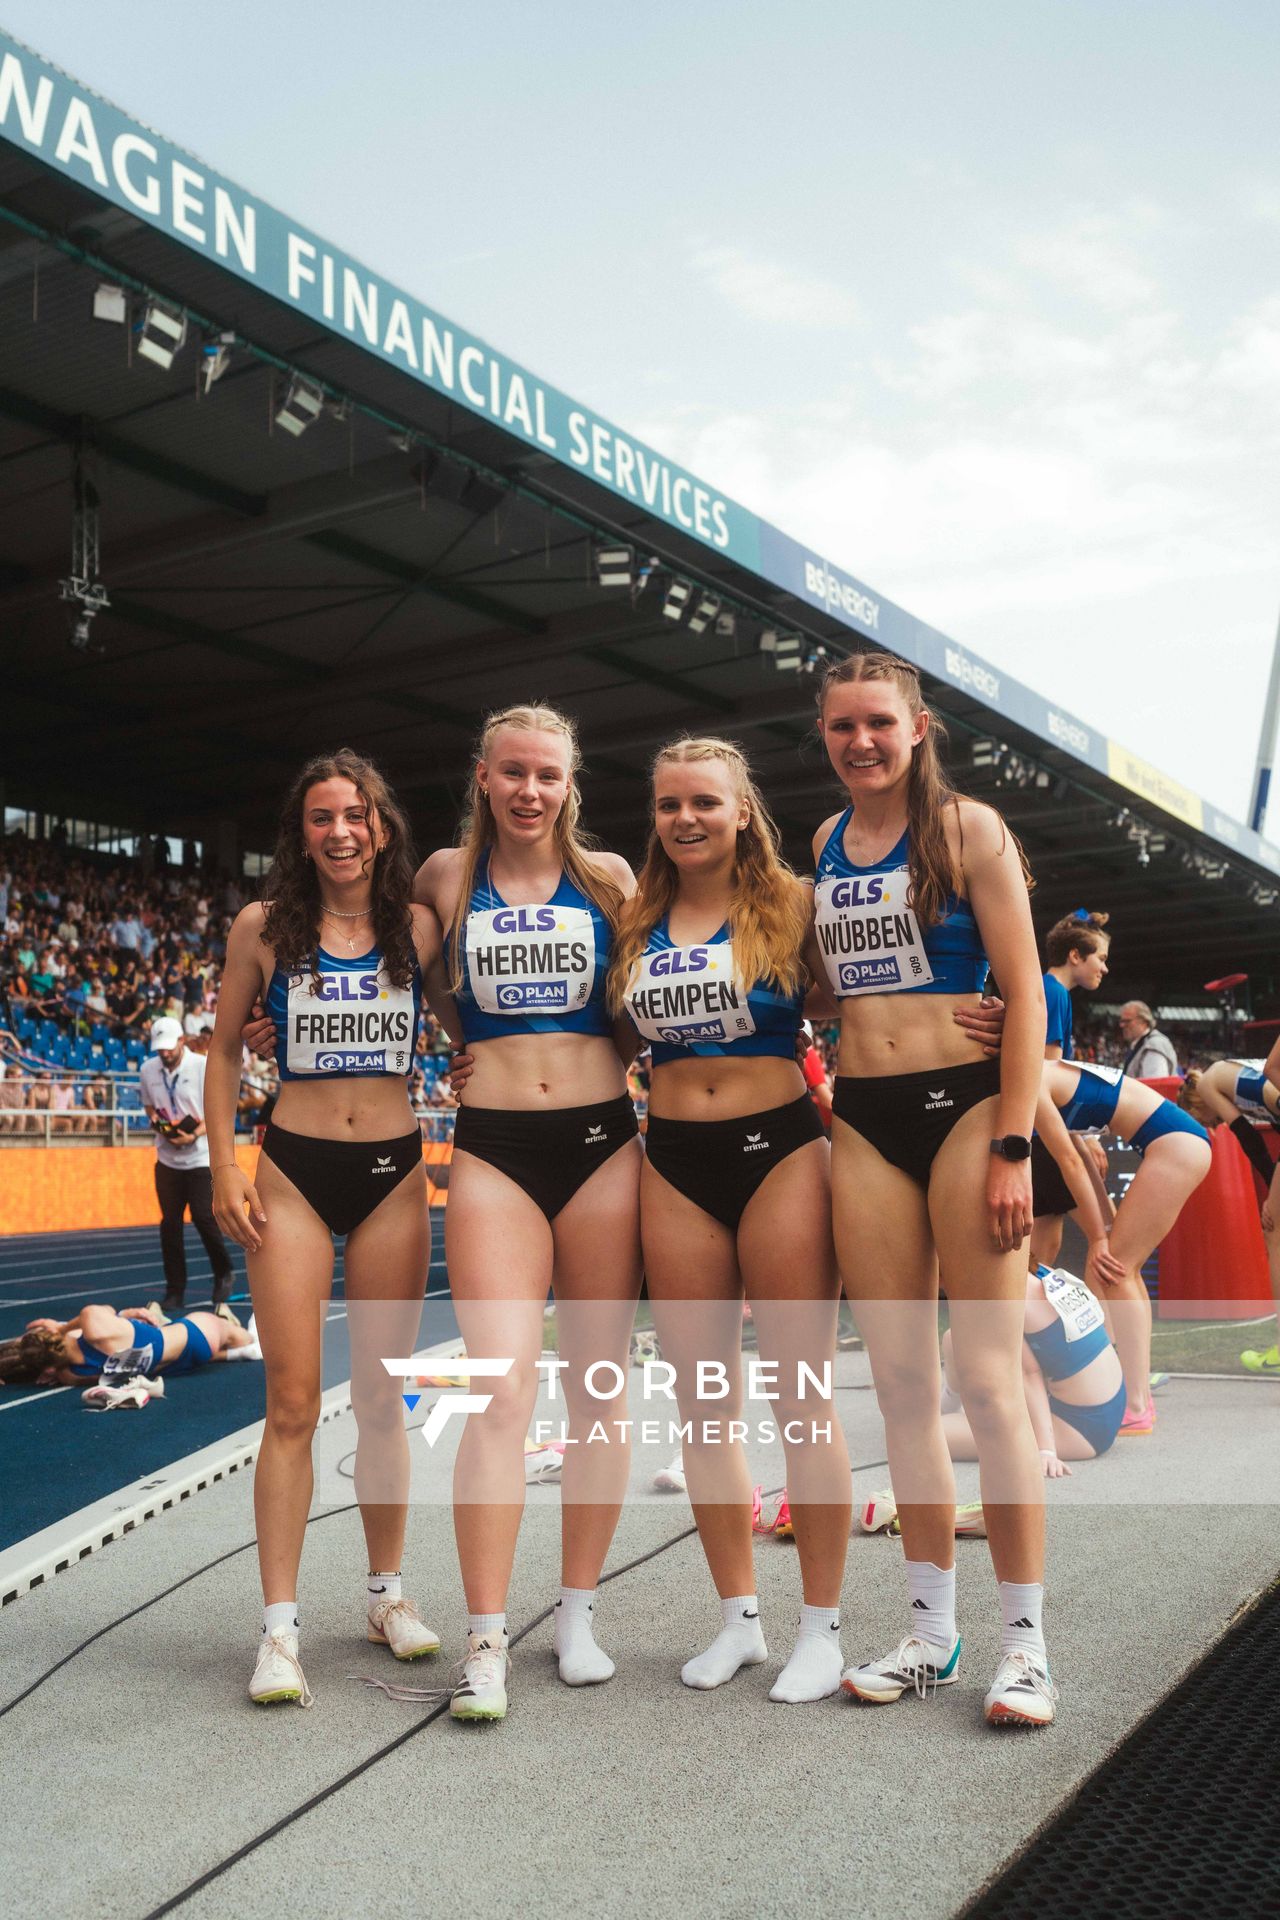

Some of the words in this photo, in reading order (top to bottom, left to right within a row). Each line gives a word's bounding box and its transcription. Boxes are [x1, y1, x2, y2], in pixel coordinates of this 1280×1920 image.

[288, 232, 556, 449] FINANCIAL
[568, 411, 729, 548] SERVICES
[818, 912, 915, 956] WÜBBEN
[476, 942, 588, 977] HERMES
[860, 961, 897, 978] PLAN
[862, 974, 898, 984] INTERNATIONAL
[525, 986, 565, 999] PLAN
[631, 980, 739, 1020] HEMPEN
[295, 1011, 409, 1044] FRERICKS
[345, 1055, 384, 1067] PLAN
[925, 1099, 954, 1110] erima
[585, 1133, 608, 1144] erima
[743, 1141, 770, 1152] erima
[371, 1165, 397, 1174] erima
